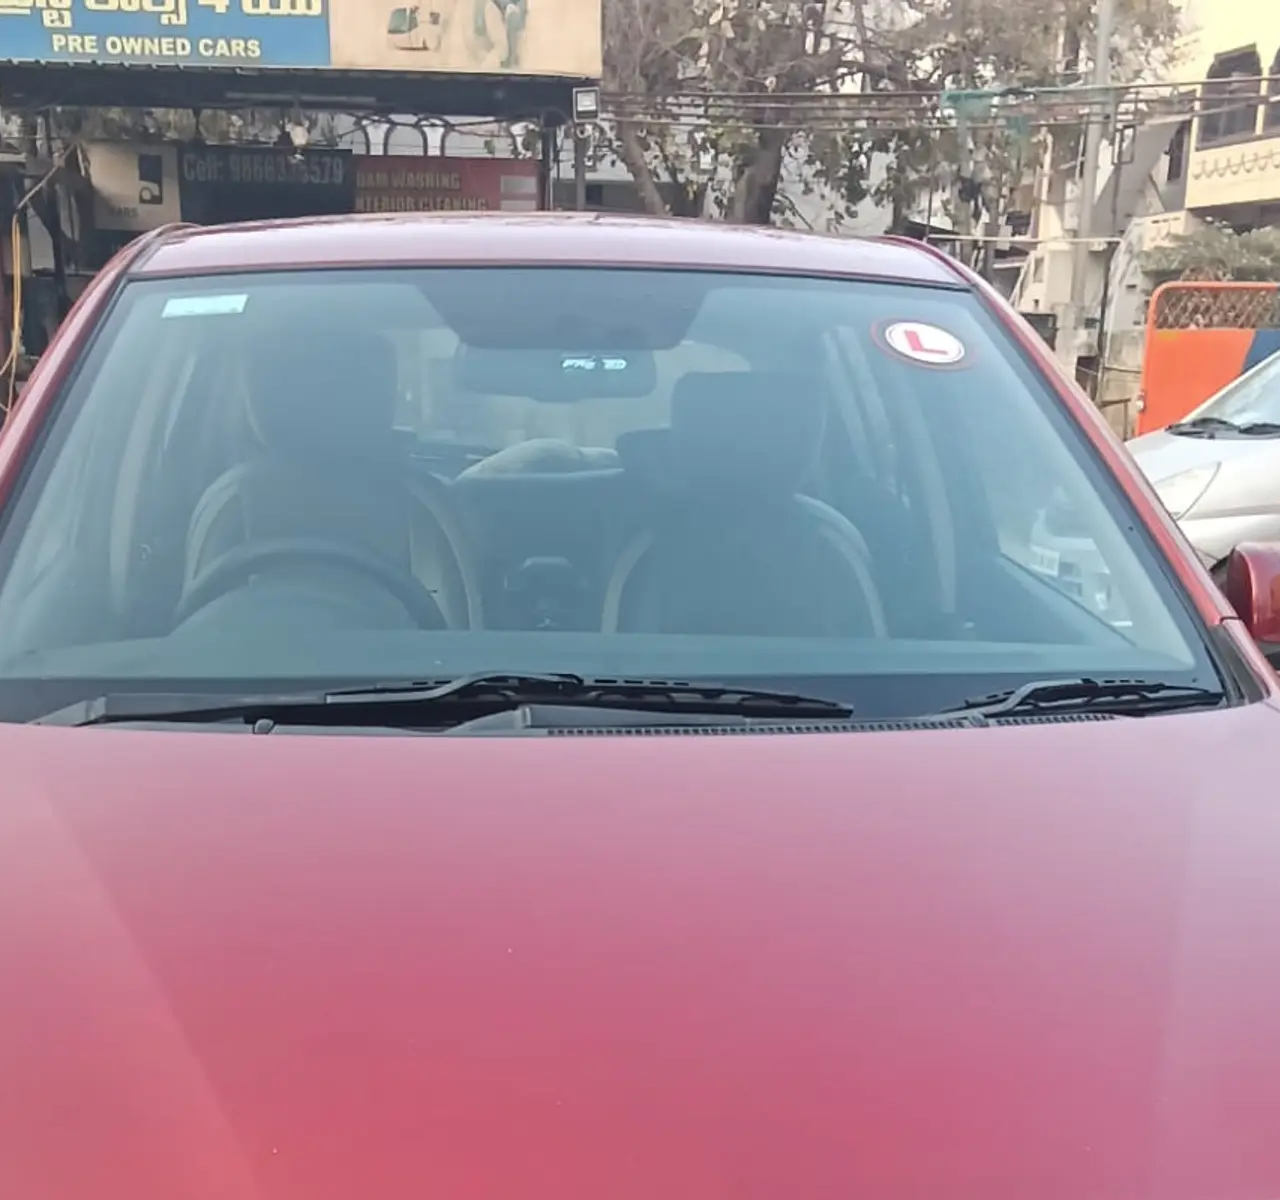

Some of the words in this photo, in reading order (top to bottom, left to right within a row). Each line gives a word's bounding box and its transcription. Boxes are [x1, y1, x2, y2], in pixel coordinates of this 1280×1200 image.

[52, 34, 98, 53] PRE
[106, 36, 192, 56] OWNED
[199, 38, 262, 57] CARS
[391, 170, 461, 190] WASHING
[903, 329, 948, 355] L
